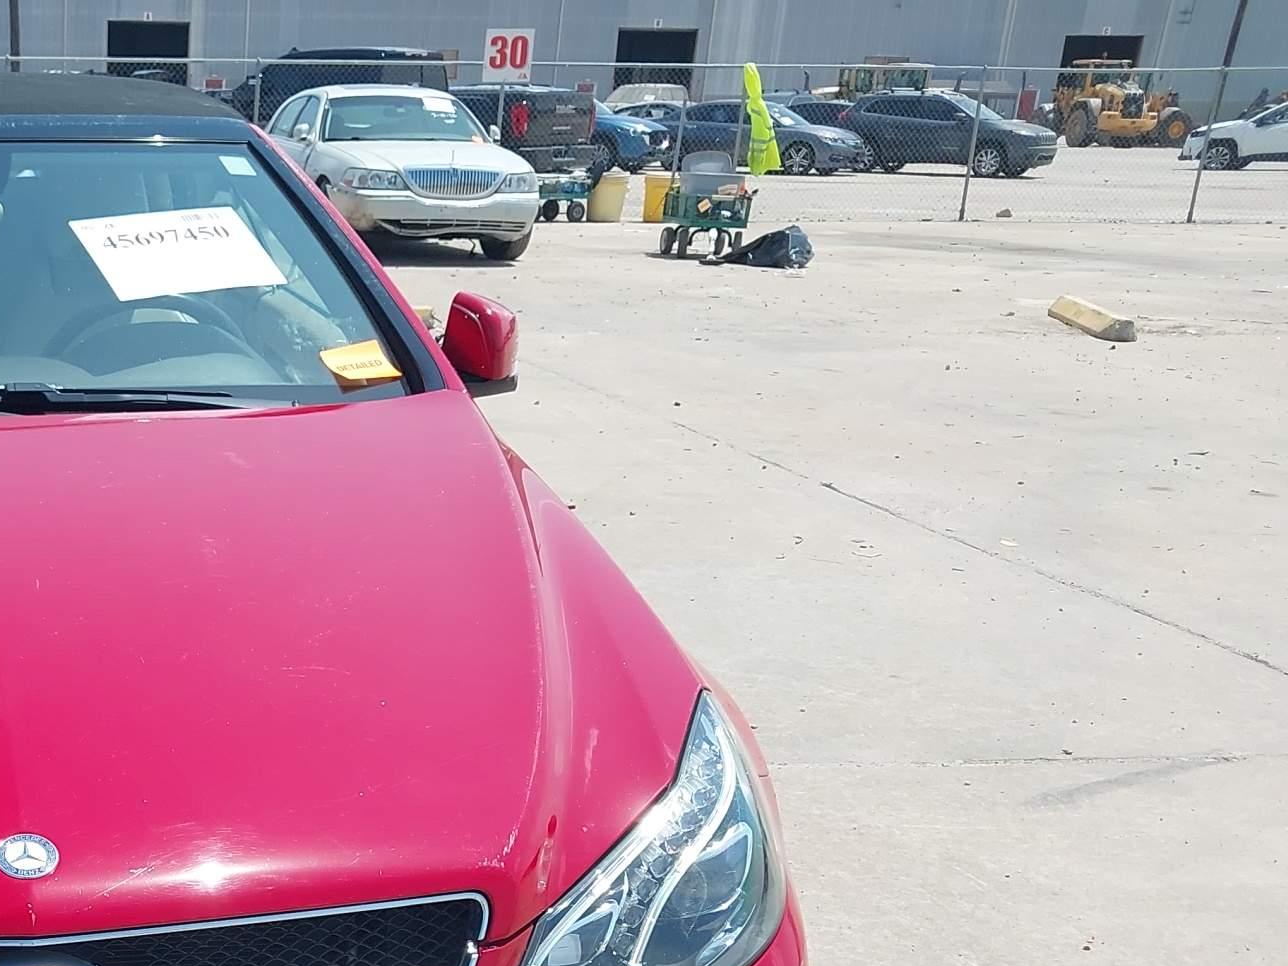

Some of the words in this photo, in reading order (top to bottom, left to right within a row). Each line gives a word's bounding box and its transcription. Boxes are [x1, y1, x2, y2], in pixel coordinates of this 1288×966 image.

[489, 35, 529, 69] 30
[103, 225, 230, 249] 45697450
[336, 359, 383, 372] DETAILED
